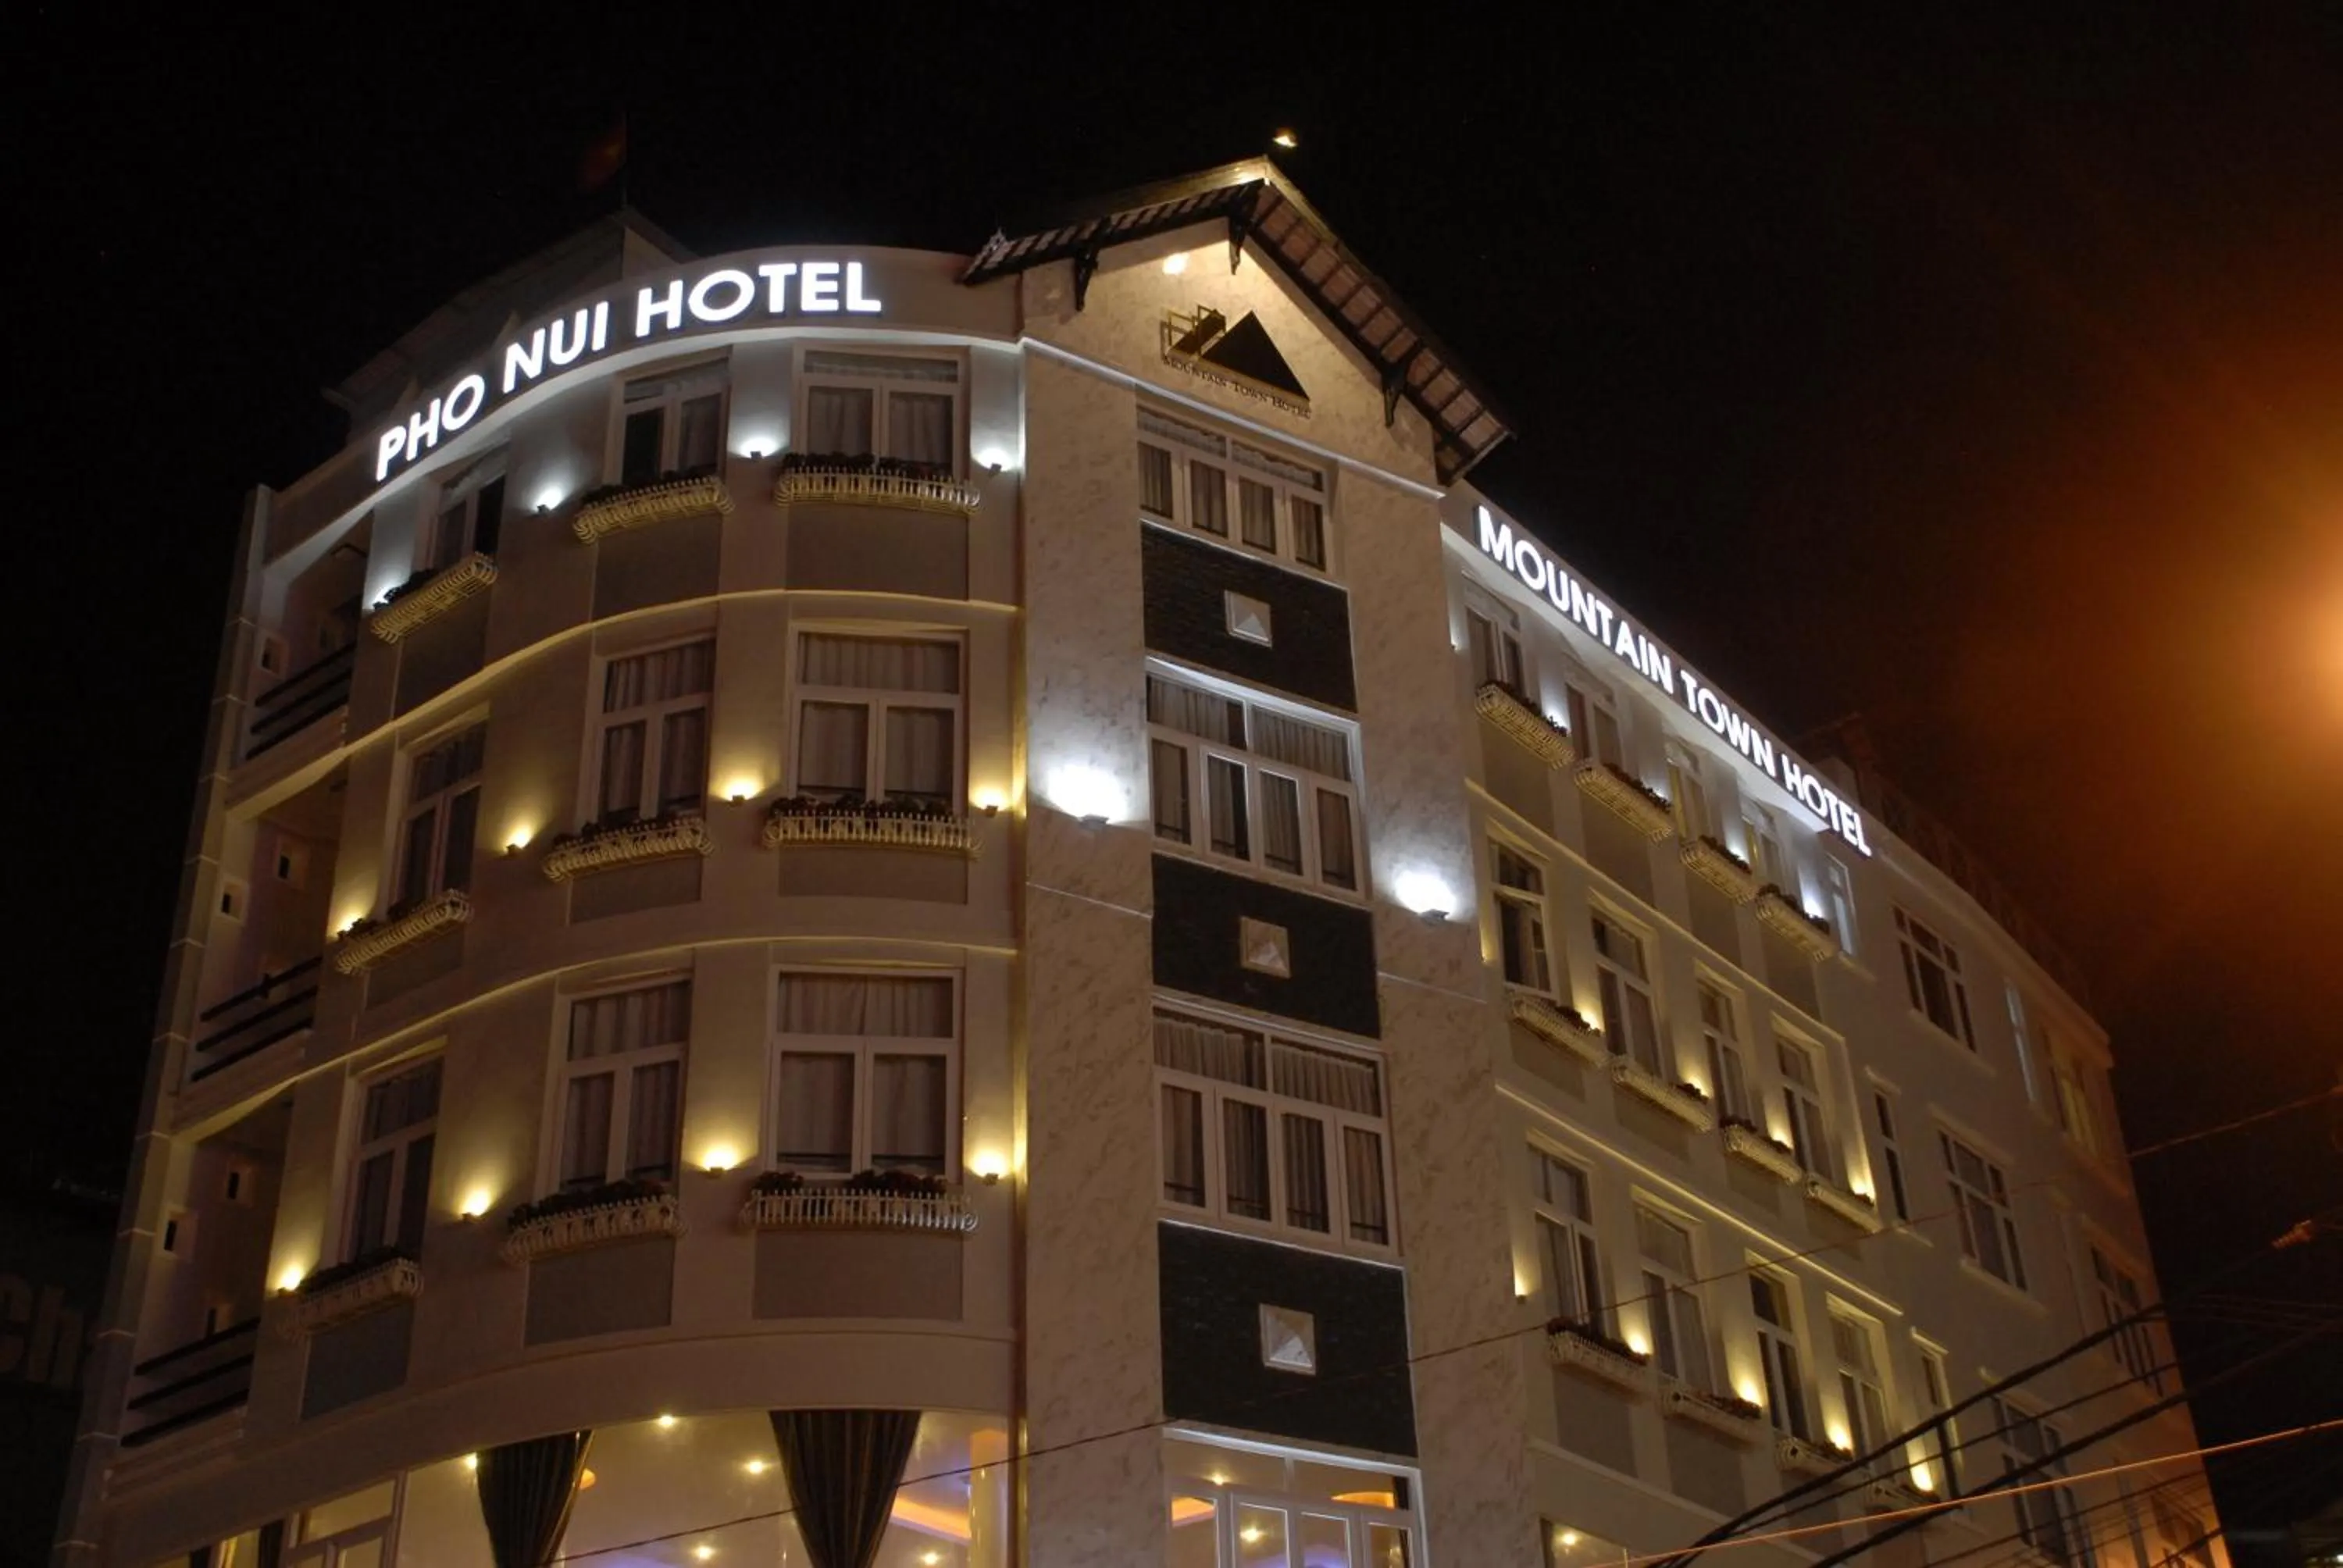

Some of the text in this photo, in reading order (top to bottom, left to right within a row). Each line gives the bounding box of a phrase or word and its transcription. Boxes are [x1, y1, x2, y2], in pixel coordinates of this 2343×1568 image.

[376, 262, 883, 482] PHO NUI HOTEL
[1478, 504, 1873, 857] MOUNTAIN TOWN HOTEL
